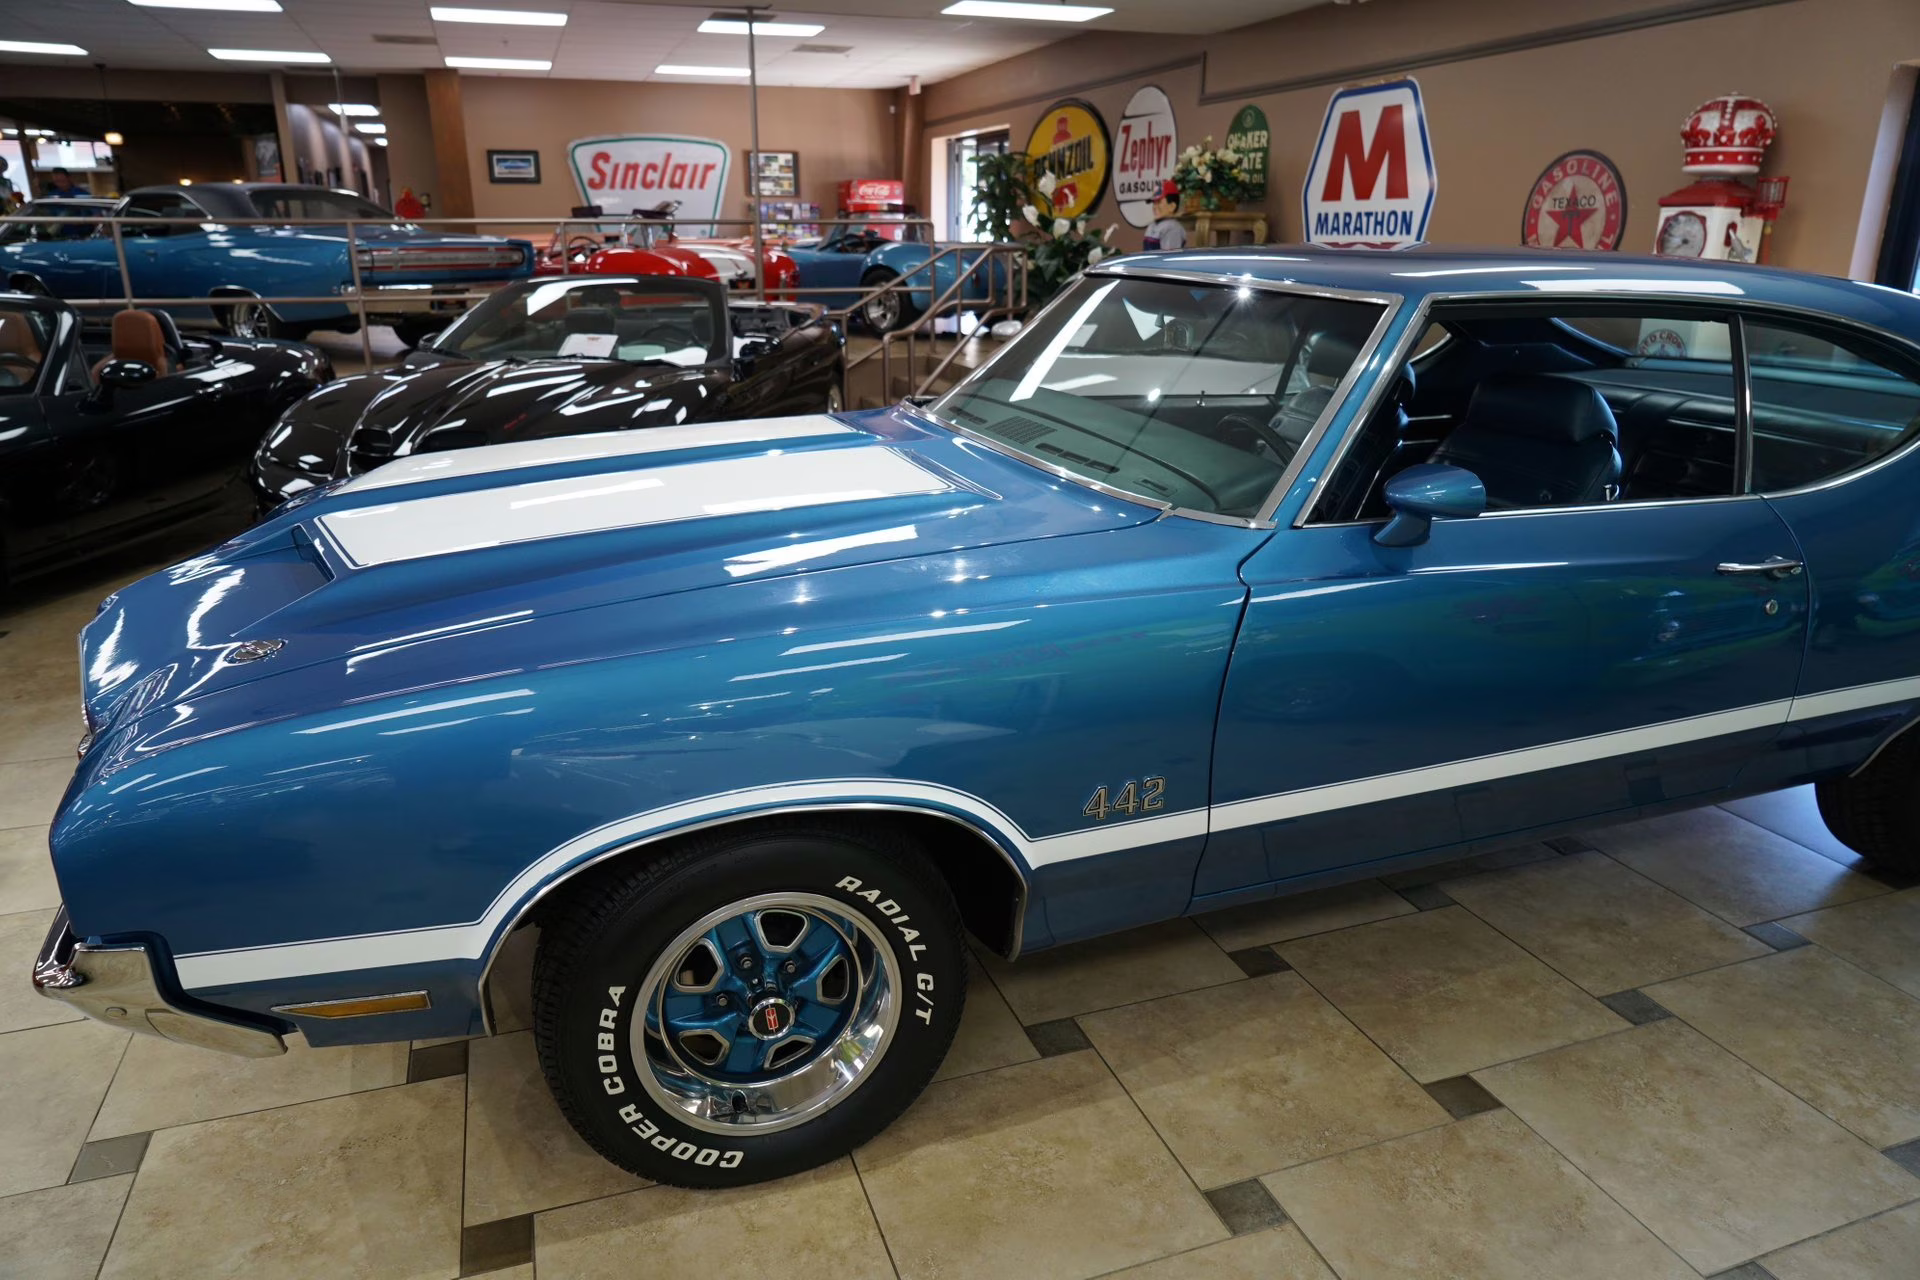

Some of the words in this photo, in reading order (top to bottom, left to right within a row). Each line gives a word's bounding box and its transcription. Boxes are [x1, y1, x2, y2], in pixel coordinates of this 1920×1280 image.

[587, 152, 717, 190] Sinclair
[1120, 120, 1172, 179] Zephyr
[1119, 180, 1163, 195] GASOLIN
[1532, 160, 1617, 209] GASOLINE
[1552, 195, 1597, 209] TEXACO
[1315, 210, 1413, 236] MARATHON
[1083, 776, 1165, 820] 442
[835, 875, 929, 962] RADIAL
[916, 972, 935, 1025] G/T
[597, 985, 627, 1096] COBRA
[618, 1103, 745, 1168] COOPER
